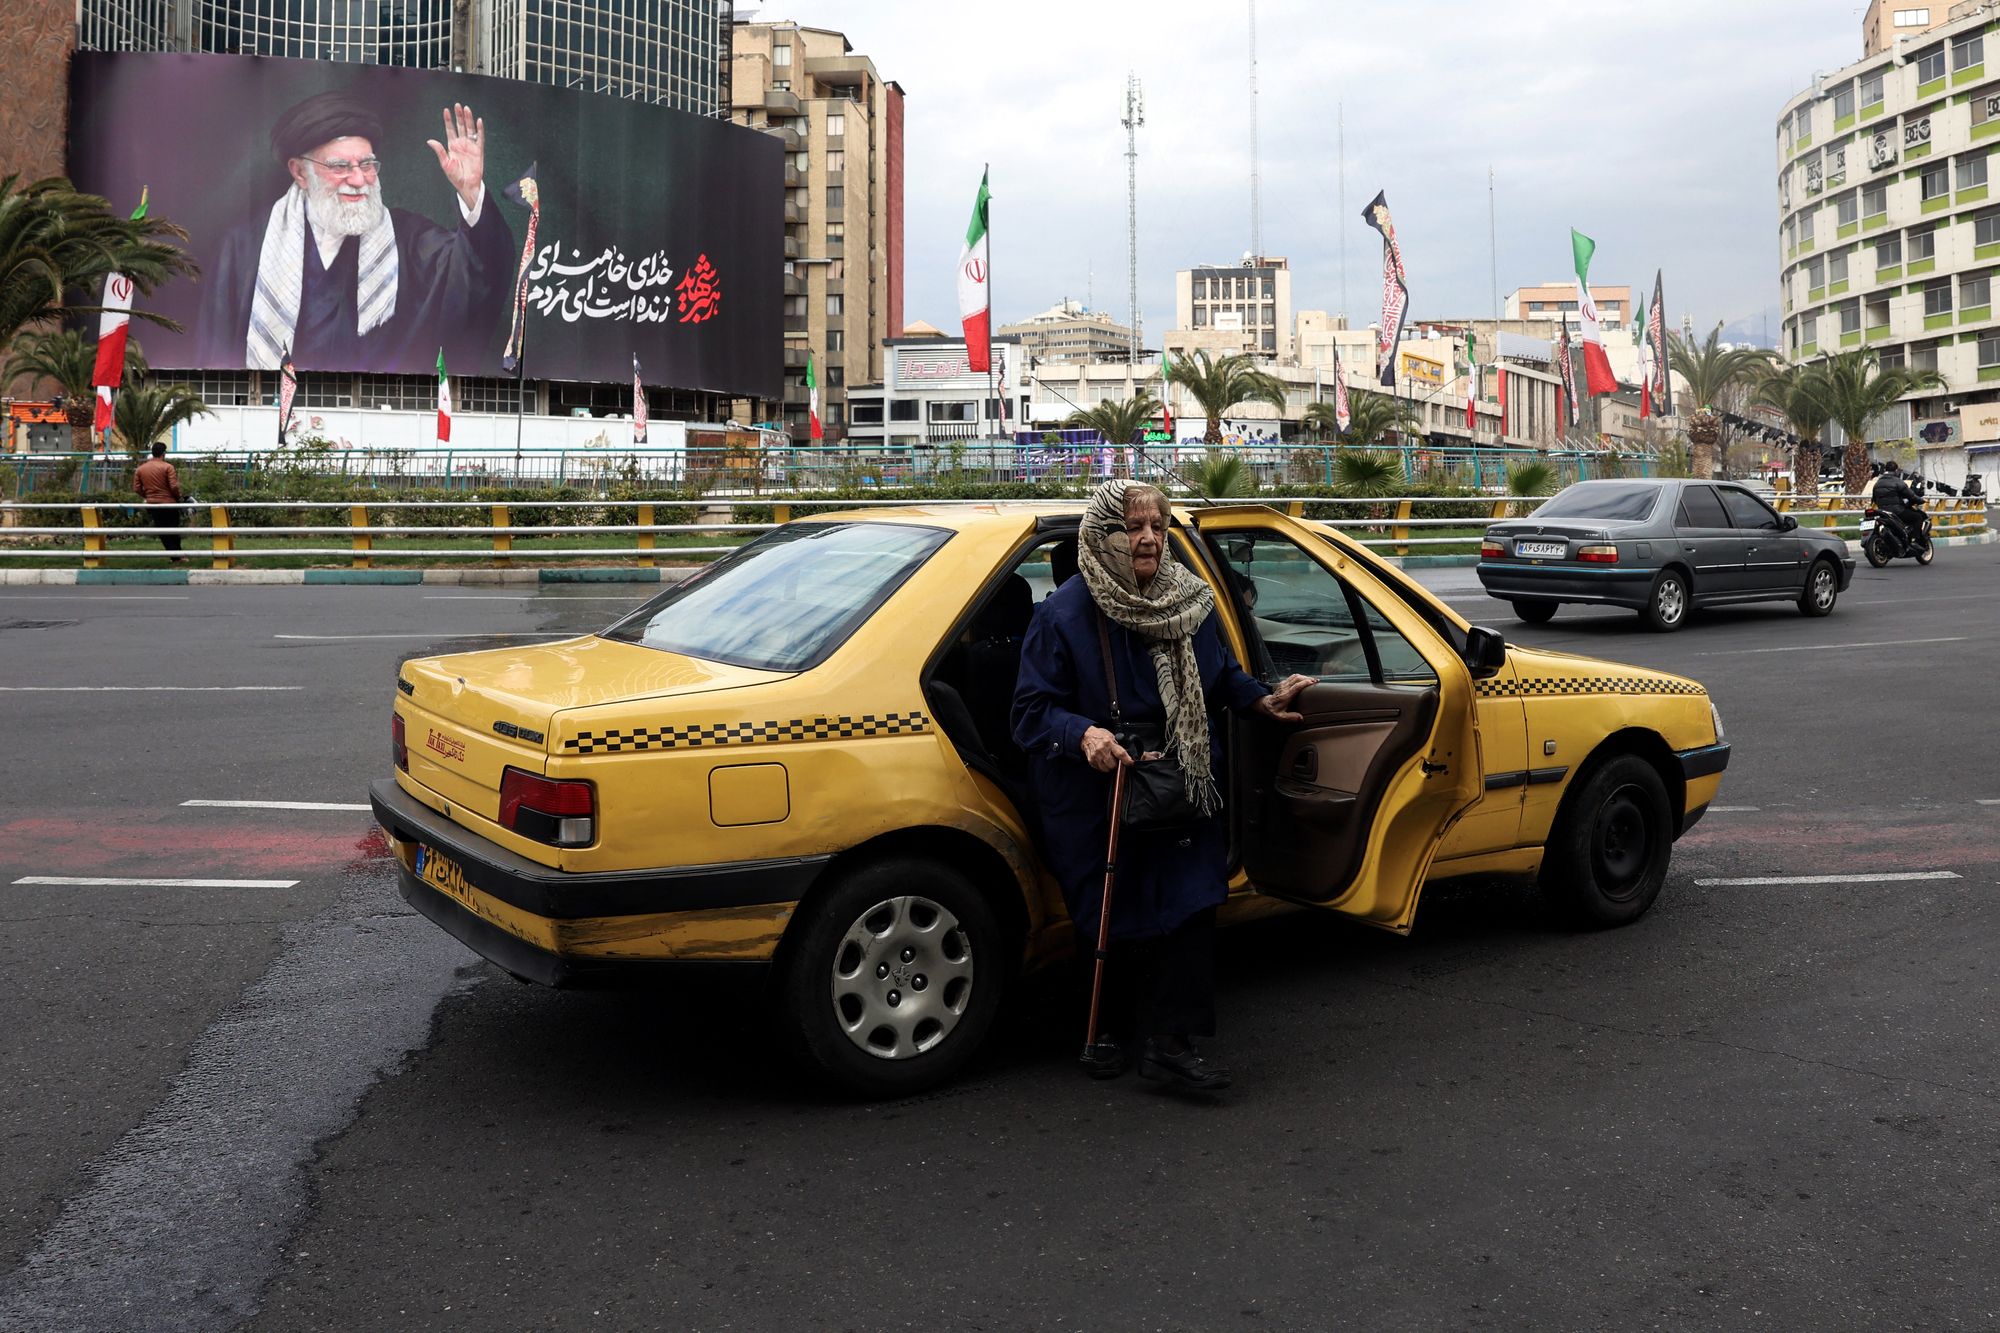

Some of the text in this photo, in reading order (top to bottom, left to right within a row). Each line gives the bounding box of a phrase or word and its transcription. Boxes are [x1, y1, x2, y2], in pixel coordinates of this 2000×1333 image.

[626, 249, 673, 290] خدای
[527, 274, 671, 323] زنده است ای مردم
